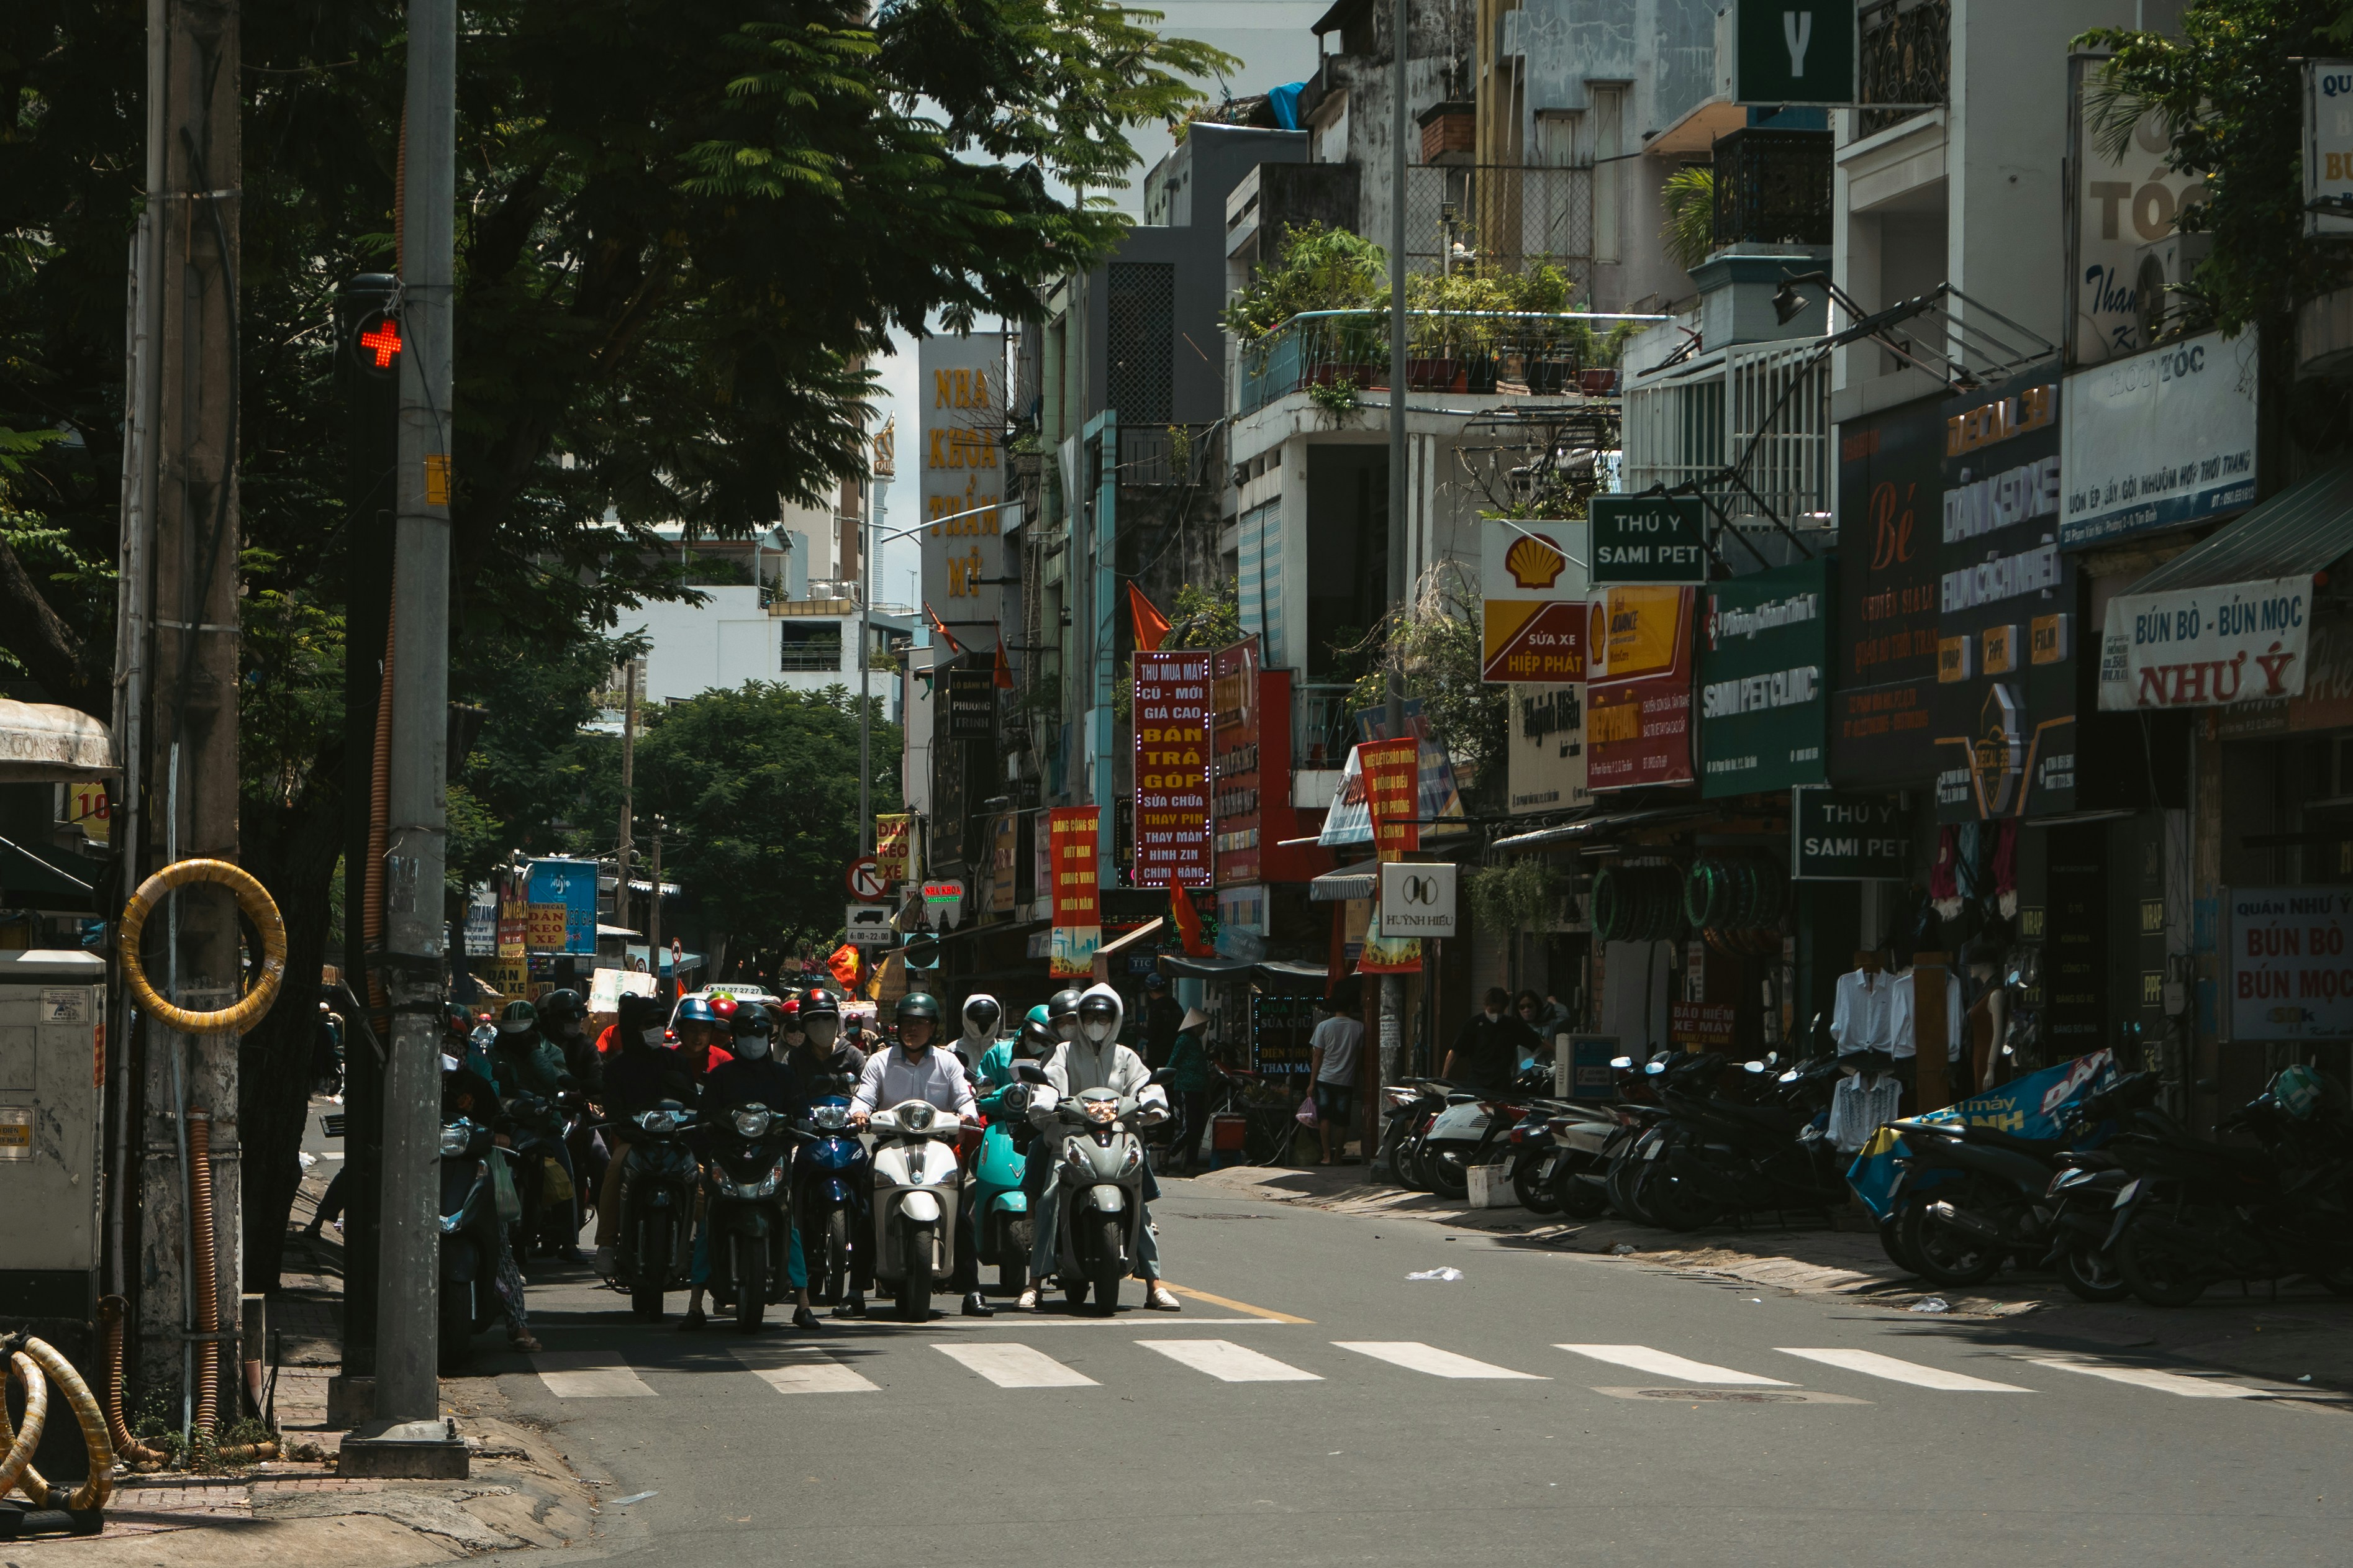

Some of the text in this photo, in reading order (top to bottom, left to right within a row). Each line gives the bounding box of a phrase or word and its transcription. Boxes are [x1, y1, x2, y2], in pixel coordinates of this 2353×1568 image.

[1784, 11, 1812, 77] Y
[2323, 75, 2353, 97] QU
[2161, 342, 2205, 383] TÓC
[934, 368, 989, 409] NHA
[929, 428, 997, 469] KHOA
[2223, 449, 2251, 478] TRANG
[929, 474, 999, 537] THẨM
[1614, 510, 1681, 532] THÚ Y
[1868, 481, 1916, 570] Bé
[1598, 545, 1699, 563] SAMI PET
[2136, 594, 2303, 645] BÚN BÒ BÚN MỌC
[1528, 630, 1576, 645] SỬA XE
[1141, 661, 1204, 681] THU MUA MÁY
[1508, 650, 1584, 676] HIỆP PHÁT
[2138, 650, 2246, 707] NHƯ
[2256, 640, 2296, 696] Ý
[1142, 684, 1204, 700] CŨ MỚI
[1703, 666, 1818, 718] SAMI PET CLINIC
[1145, 704, 1201, 720] GIÁ CAO
[1143, 725, 1202, 743] BÁN
[1145, 745, 1201, 766] TRẢ
[1143, 769, 1204, 789] GÓP
[1144, 792, 1168, 808] SỬA
[1171, 792, 1204, 807] CHỮA
[1145, 813, 1204, 825] THAY PIN
[1822, 800, 1893, 823] THÚ Y
[877, 818, 909, 837] DÁN
[1145, 831, 1174, 844] THAY
[1176, 828, 1203, 843] MÀN
[878, 843, 909, 858] KEO
[1076, 845, 1091, 857] NAM
[1149, 846, 1199, 861] HÌNH ZIN
[1805, 838, 1910, 858] SAMI PET
[883, 864, 902, 879] XE
[925, 886, 963, 896] NHA KHOA
[1079, 895, 1094, 910] NĂM
[2237, 892, 2352, 917] QUÁN NHƯ Ý
[528, 910, 564, 921] DÁN
[1387, 913, 1426, 927] HUỲNH
[2023, 910, 2044, 935] WRAP
[2141, 904, 2163, 930] WRAP
[529, 924, 563, 933] KEO
[2247, 918, 2344, 958] BÚN BÒ
[535, 935, 557, 943] XE
[509, 982, 526, 994] XE
[2144, 975, 2162, 1002] PPF
[2237, 962, 2353, 1005] BÚN MỌC
[1674, 1002, 1734, 1021] BẢO HIỂM
[1674, 1018, 1733, 1033] XE MÁY
[1261, 1060, 1312, 1074] THAY MÀ
